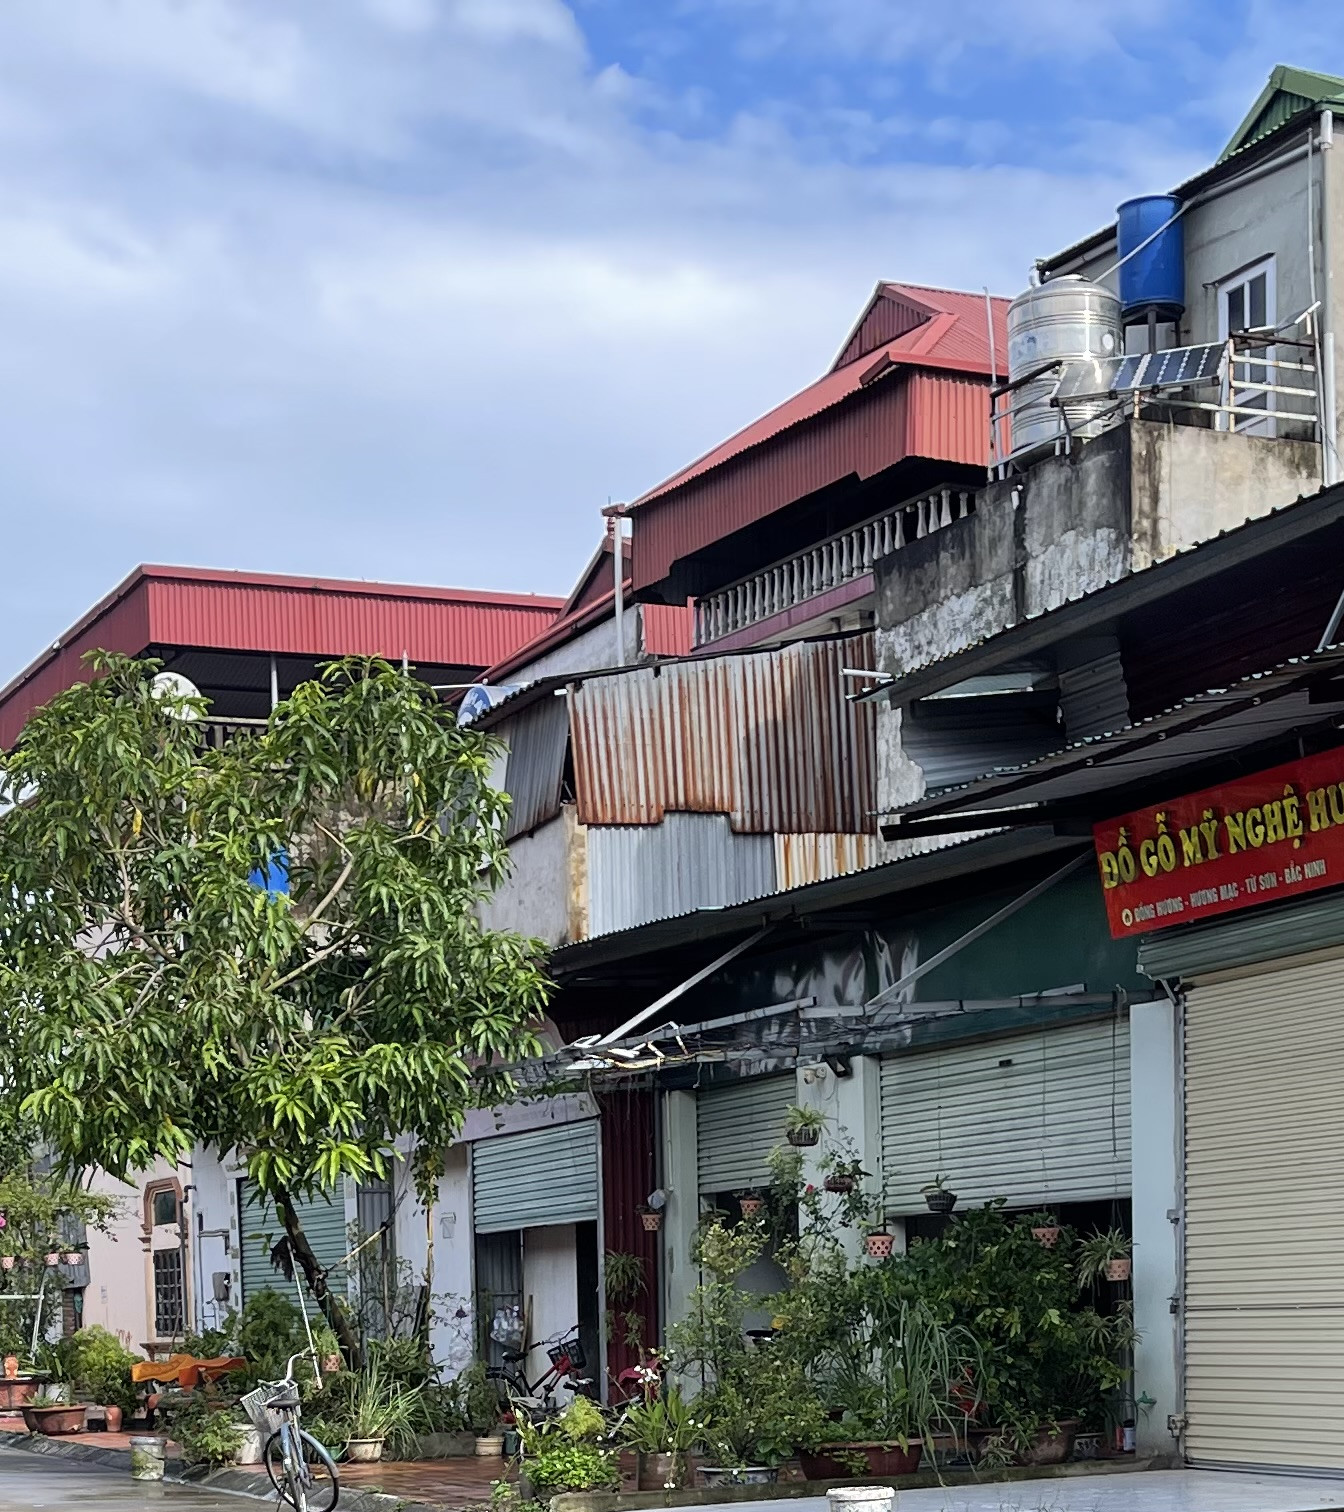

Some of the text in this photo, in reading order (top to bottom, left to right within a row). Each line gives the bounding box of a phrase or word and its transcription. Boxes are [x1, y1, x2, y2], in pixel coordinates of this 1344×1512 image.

[1100, 826, 1136, 889] ĐỒ
[1140, 811, 1176, 877] GỖ
[1179, 808, 1219, 867] MỸ
[1224, 784, 1303, 854] NGHỆ
